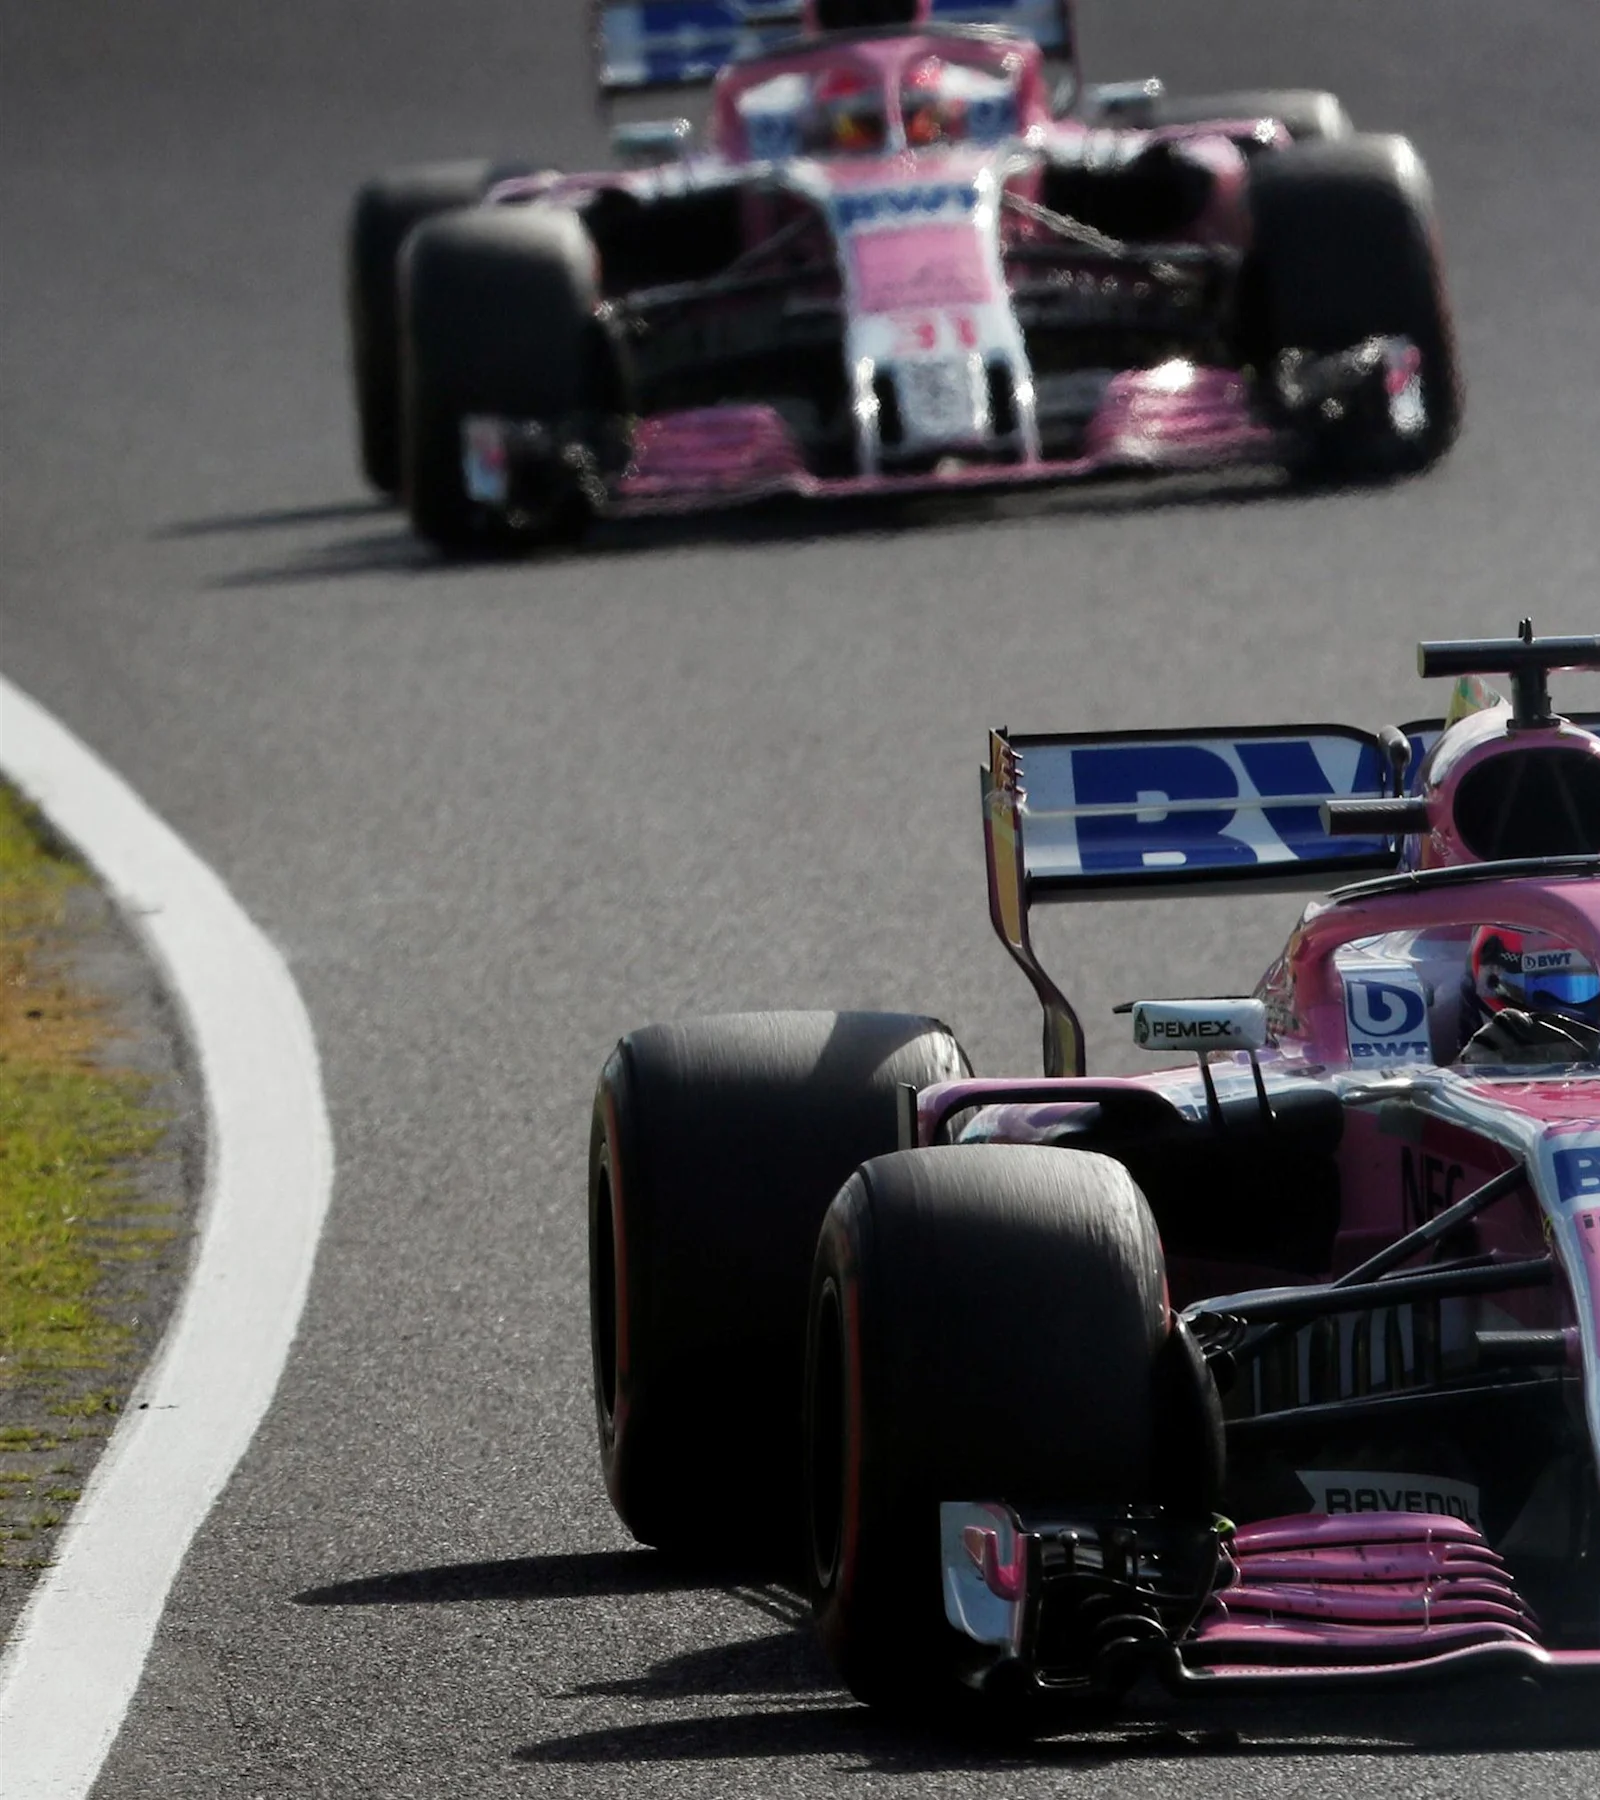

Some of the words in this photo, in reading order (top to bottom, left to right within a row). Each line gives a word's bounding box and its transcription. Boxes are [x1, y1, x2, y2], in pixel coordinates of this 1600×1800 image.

[1538, 953, 1572, 967] BWT
[1153, 1019, 1231, 1038] PEMEX
[1351, 1041, 1428, 1058] BWT
